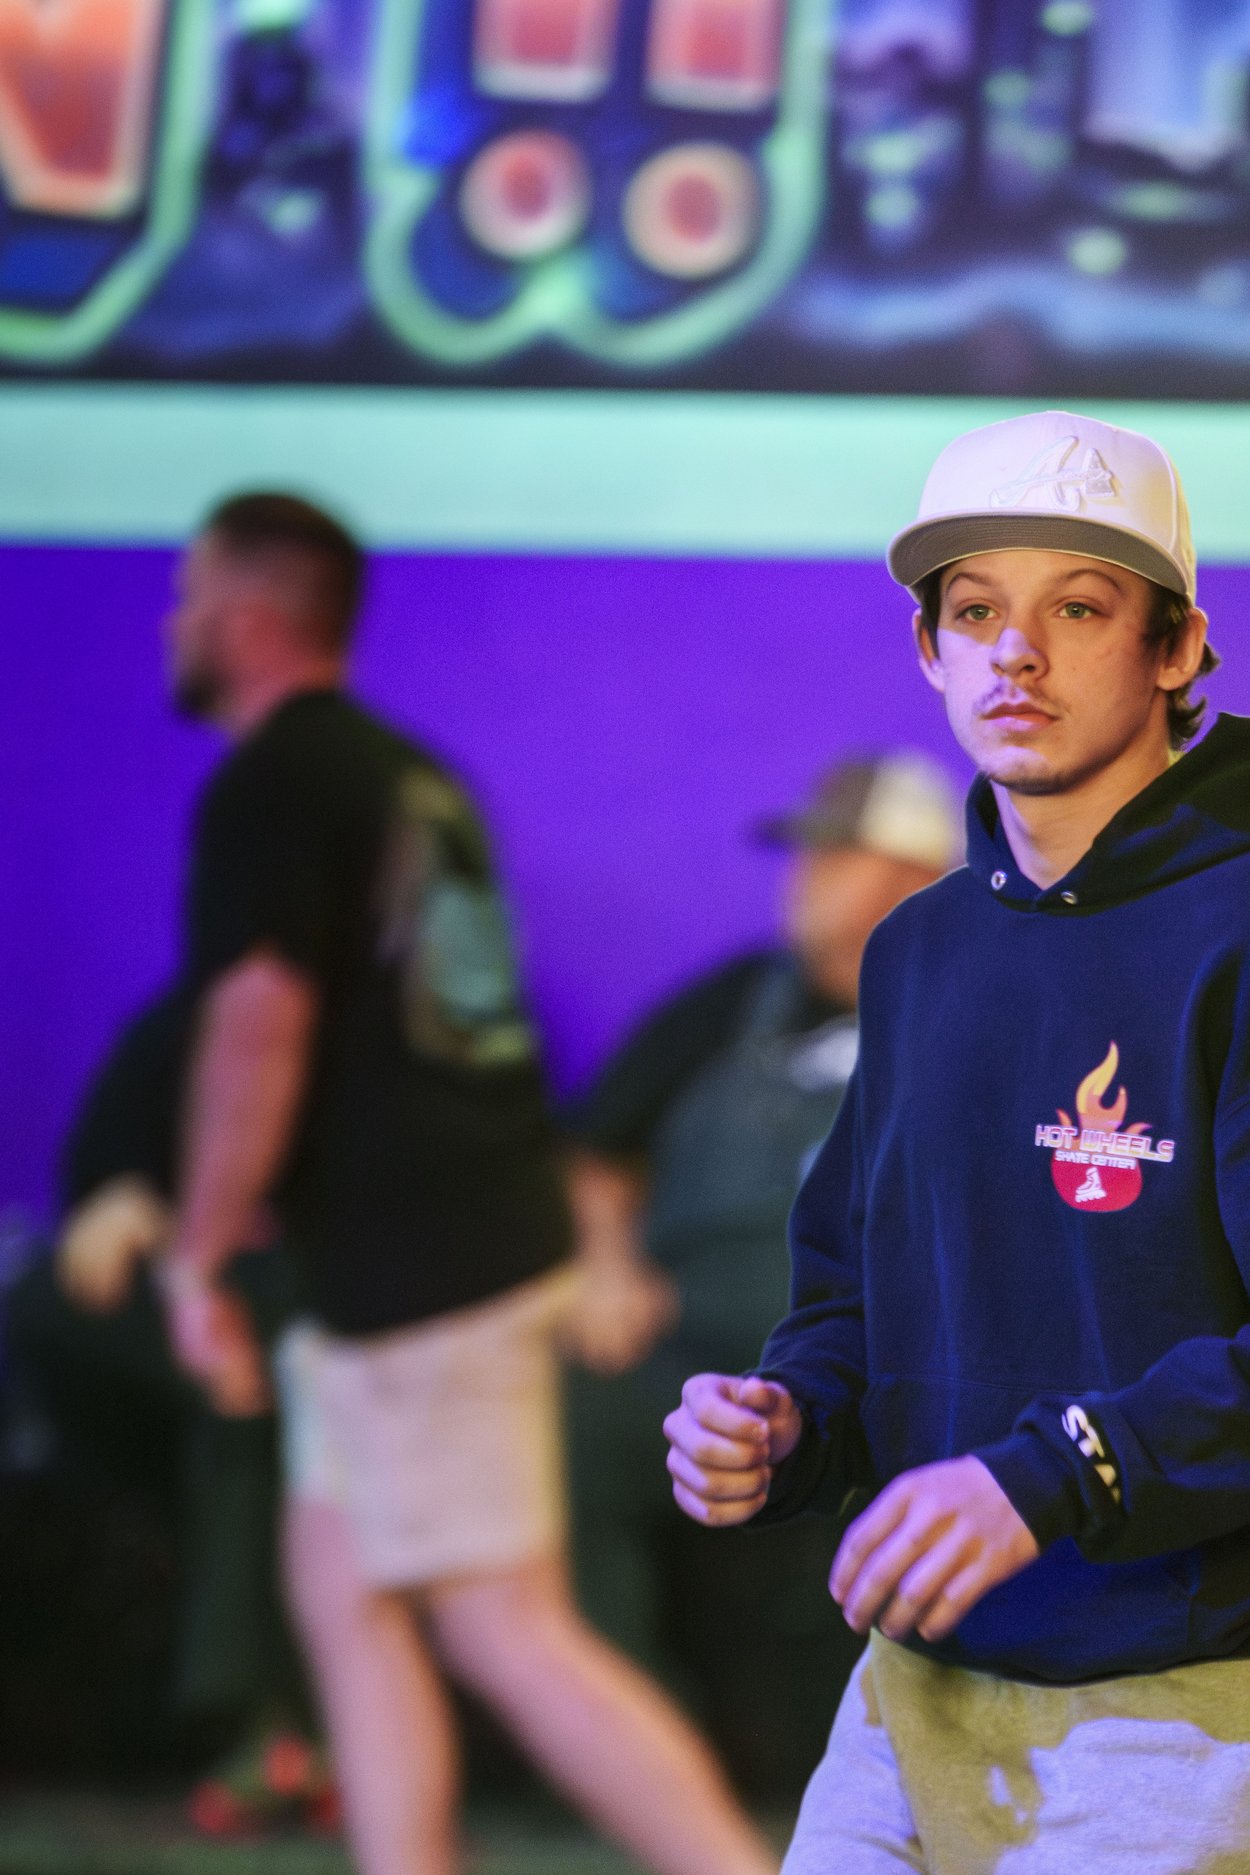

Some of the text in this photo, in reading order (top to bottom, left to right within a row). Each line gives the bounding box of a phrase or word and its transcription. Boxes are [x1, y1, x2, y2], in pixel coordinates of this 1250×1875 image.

[1034, 1124, 1176, 1163] HOT WHEELS
[1055, 1150, 1137, 1169] SKATE CENTER
